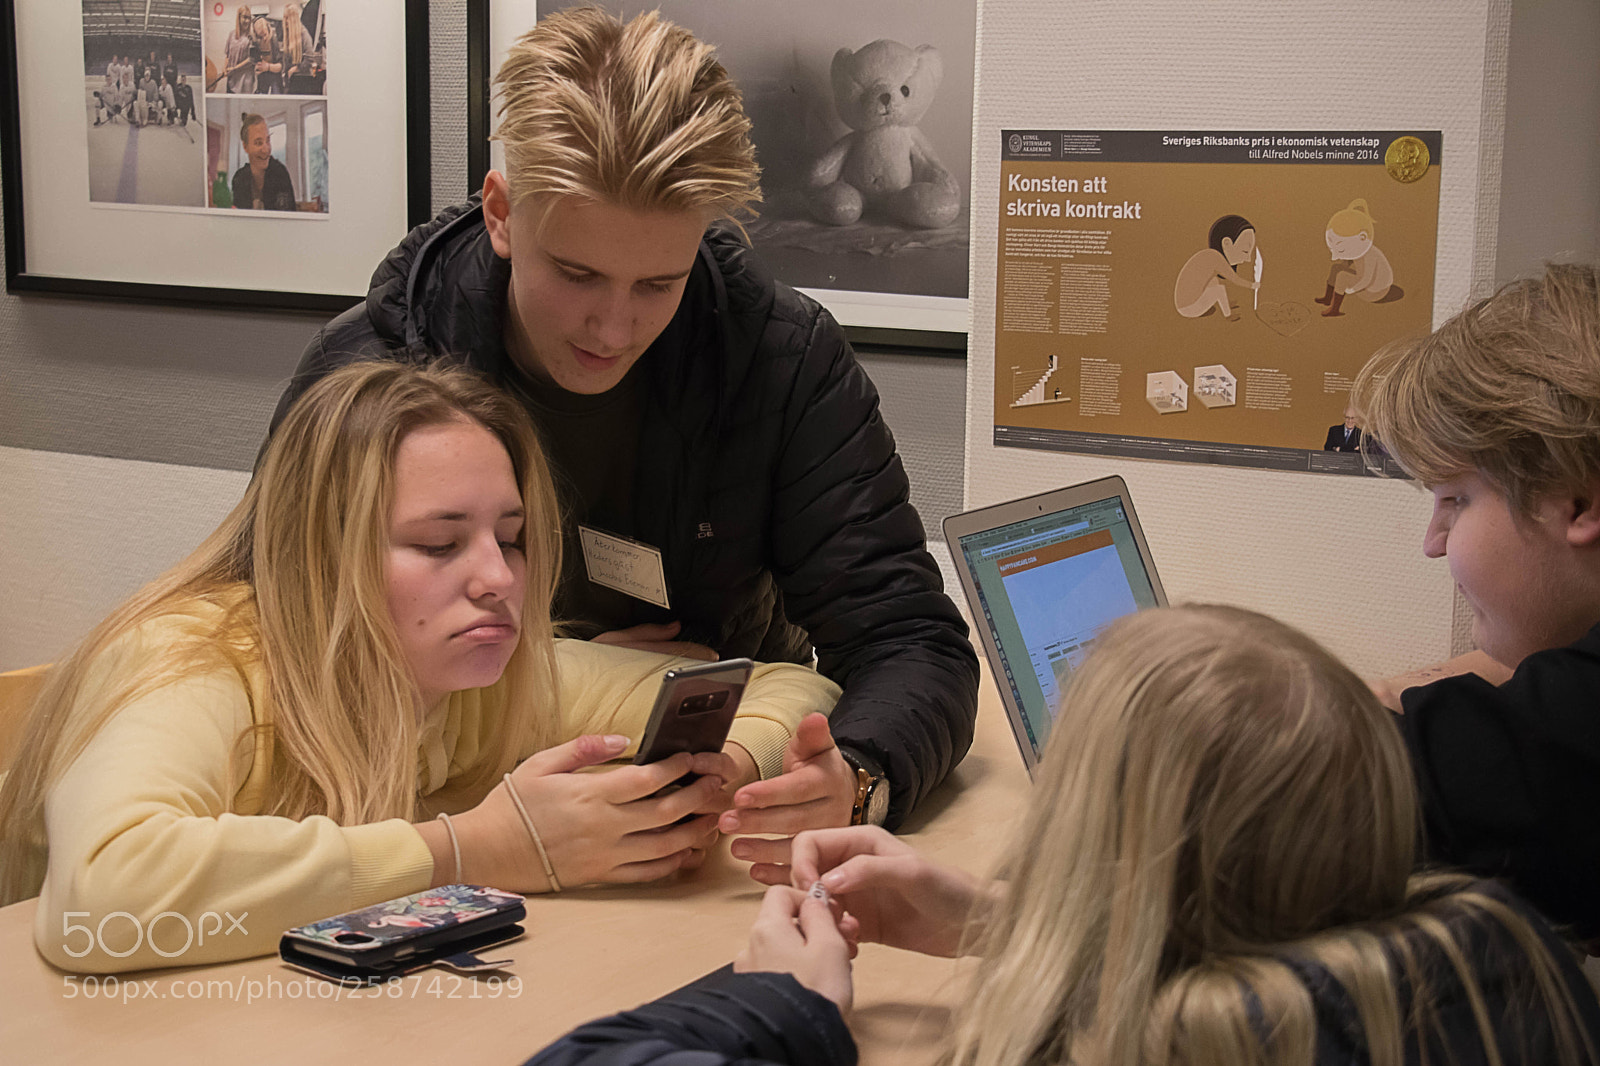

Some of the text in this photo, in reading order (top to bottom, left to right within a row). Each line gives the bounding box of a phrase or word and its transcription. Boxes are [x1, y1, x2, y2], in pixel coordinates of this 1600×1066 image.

[1162, 136, 1380, 149] Sveriges Riksbanks pris i ekonomisk vetenskap
[1249, 150, 1379, 160] till Alfred Nobels minne 2016
[1008, 174, 1107, 194] Konsten att
[1007, 198, 1142, 219] skriva kontrakt
